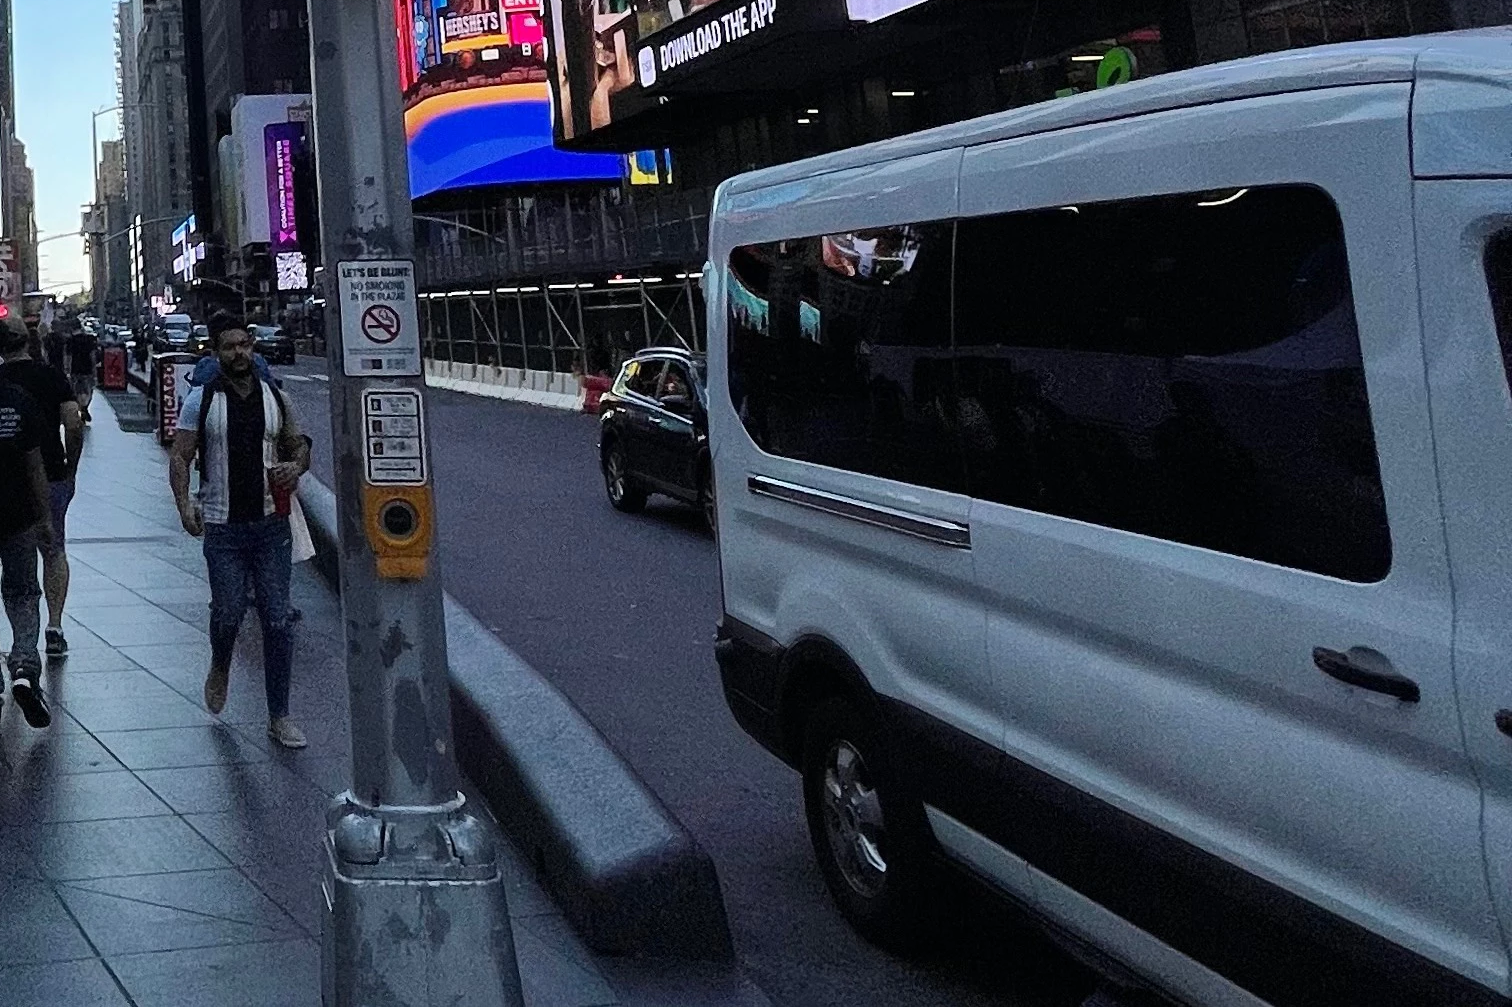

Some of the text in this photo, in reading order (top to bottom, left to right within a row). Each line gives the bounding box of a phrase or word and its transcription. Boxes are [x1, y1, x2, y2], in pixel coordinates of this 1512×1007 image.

[659, 20, 722, 72] DOWNLOAD
[720, 6, 750, 43] THE
[350, 281, 364, 291] NO
